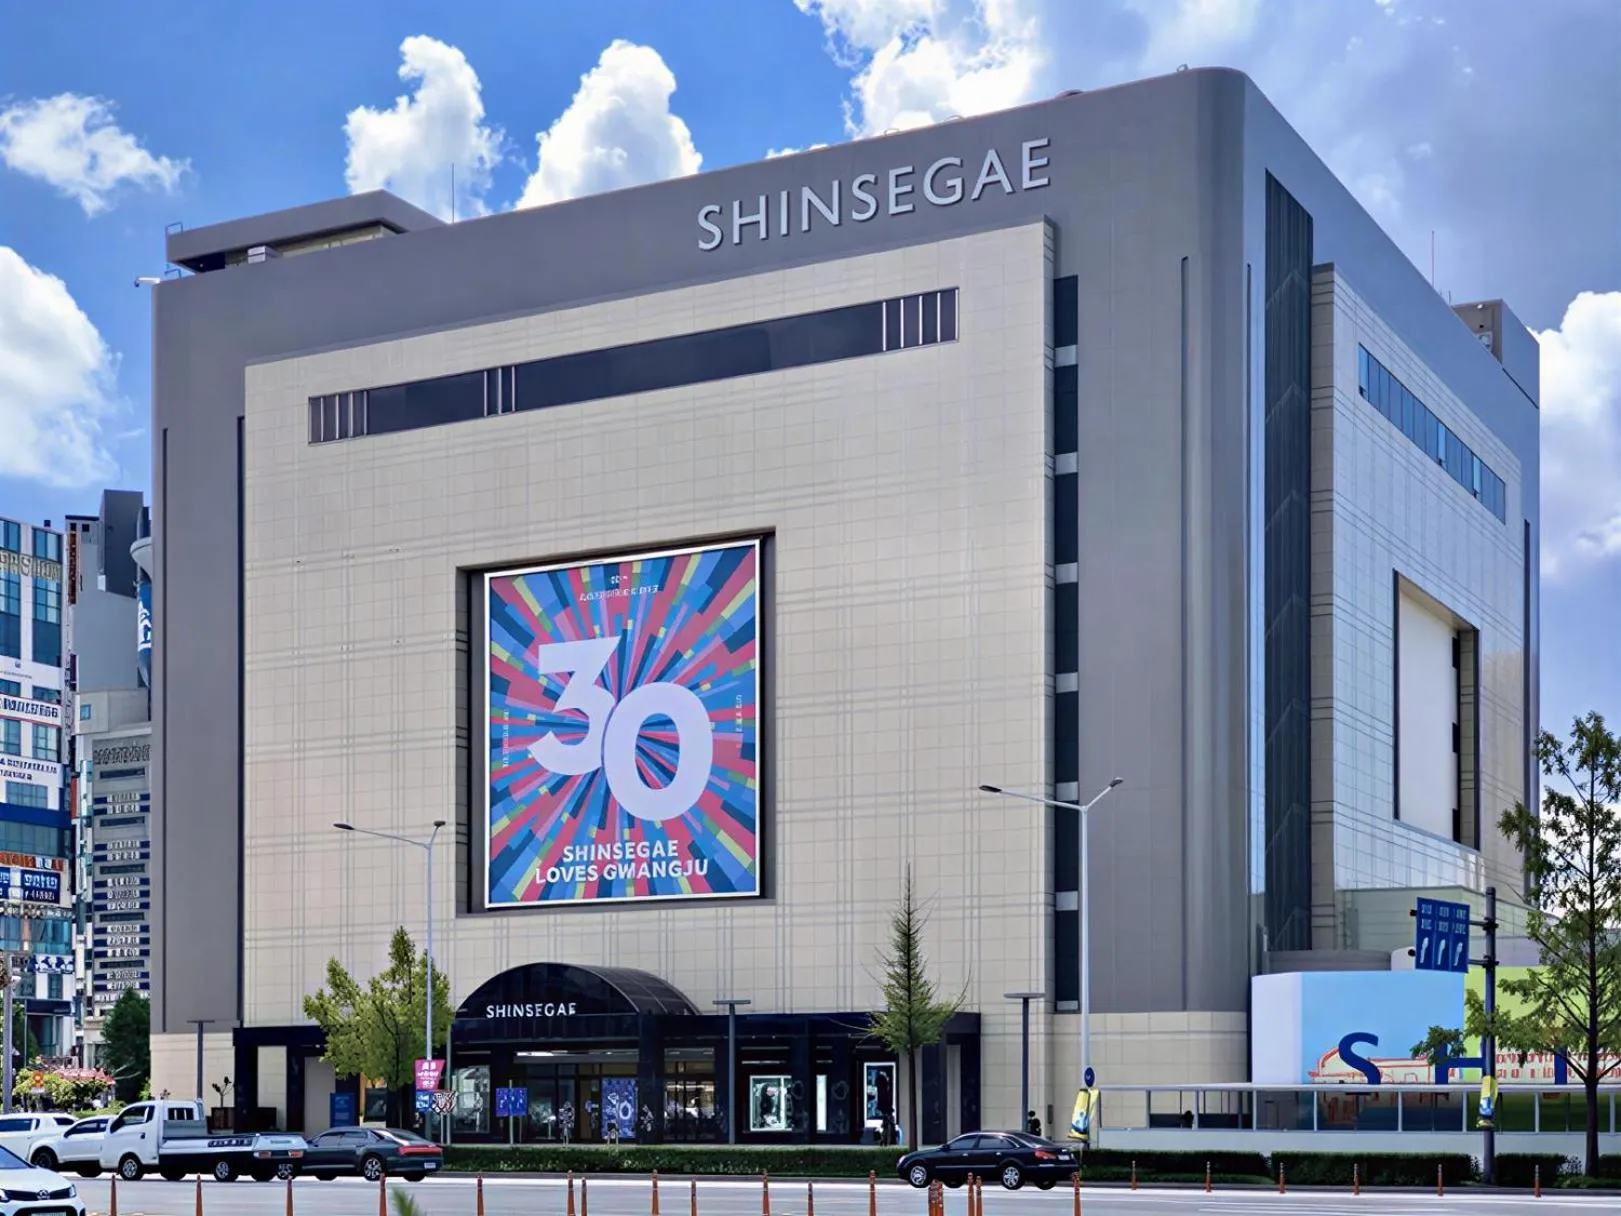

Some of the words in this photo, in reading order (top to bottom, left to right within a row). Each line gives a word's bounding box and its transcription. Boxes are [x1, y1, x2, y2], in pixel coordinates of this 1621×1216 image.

[697, 137, 1052, 252] SHINSEGAE
[527, 635, 714, 821] 30
[562, 839, 679, 863] SHINSEGAE
[535, 864, 599, 884] LOVES
[602, 858, 709, 881] GWANGJU
[486, 1002, 577, 1019] SHINSEGAE
